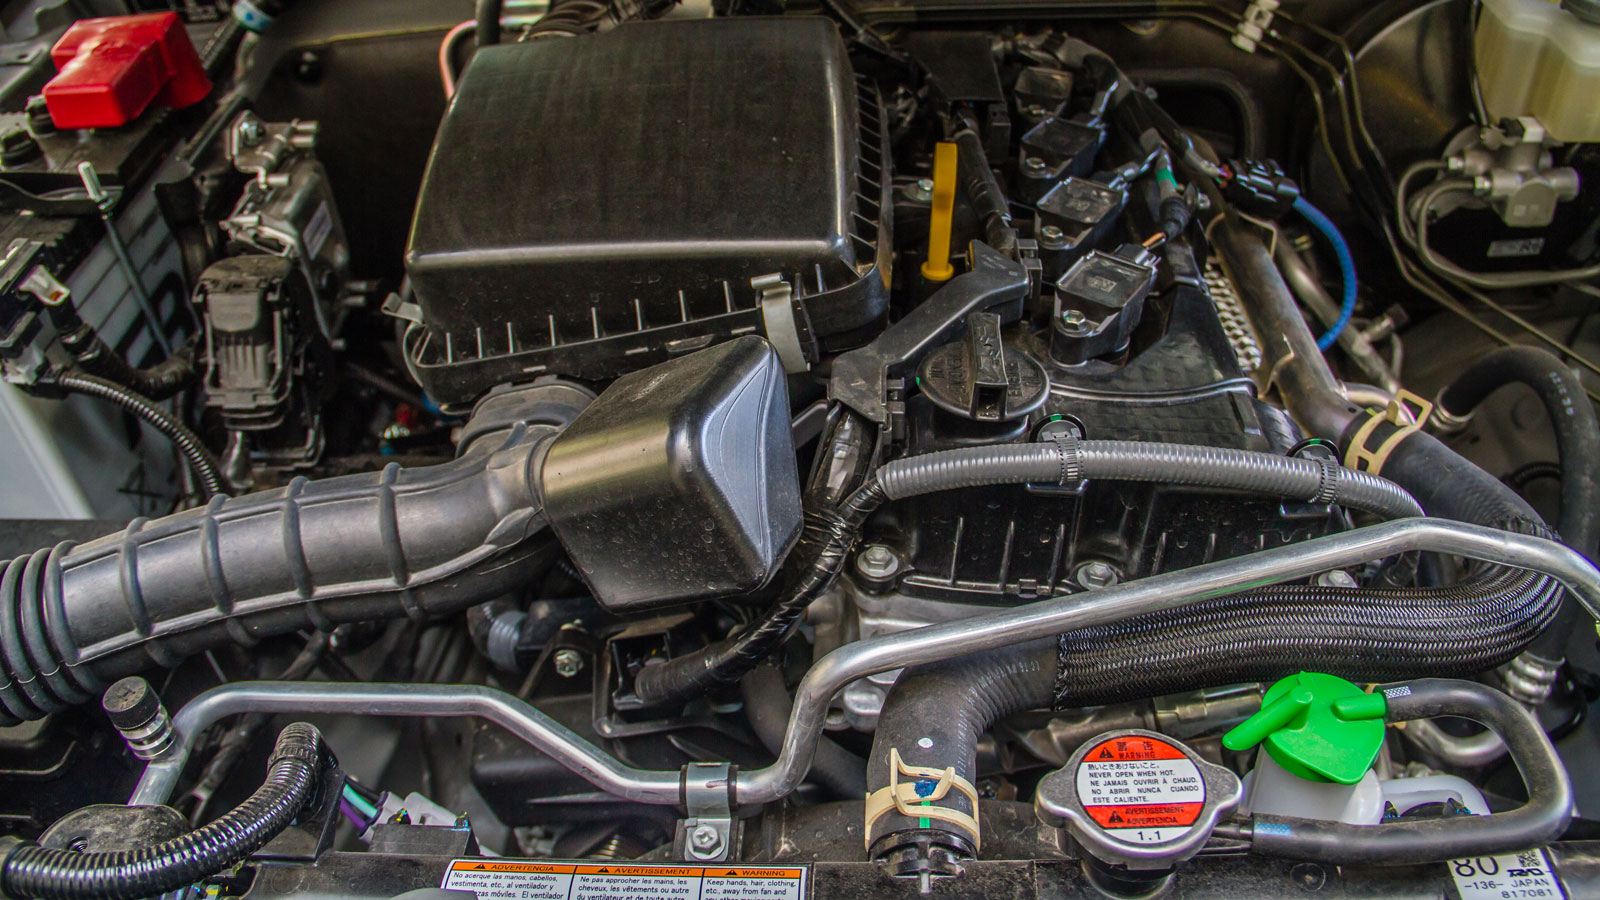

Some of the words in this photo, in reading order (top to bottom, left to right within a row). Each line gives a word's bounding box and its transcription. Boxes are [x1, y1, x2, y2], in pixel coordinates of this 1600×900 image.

[1119, 751, 1156, 759] WARNING
[1103, 779, 1128, 787] JAMAIS
[1133, 778, 1159, 786] OUVRIR
[1109, 787, 1130, 795] ABRIR
[1137, 786, 1161, 794] NUNCA
[1170, 785, 1199, 793] CUANDO
[1125, 806, 1184, 815] AVERTISSEMENT
[1126, 816, 1178, 825] ADVERTENCIA
[1137, 830, 1161, 840] 1.1
[491, 864, 554, 872] ADVERTENCIA
[1452, 855, 1499, 877] 80
[451, 880, 488, 888] vestimenta,
[514, 882, 548, 890] ventilador
[605, 877, 640, 885] approcher
[653, 878, 675, 886] mains,
[1510, 878, 1550, 888] JAPAN
[578, 885, 608, 893] cheveux,
[622, 885, 658, 894] vêtements
[742, 887, 759, 895] from
[760, 887, 772, 895] fan
[1501, 888, 1553, 899] 817081
[521, 890, 529, 898] El
[530, 892, 564, 900] ventilador
